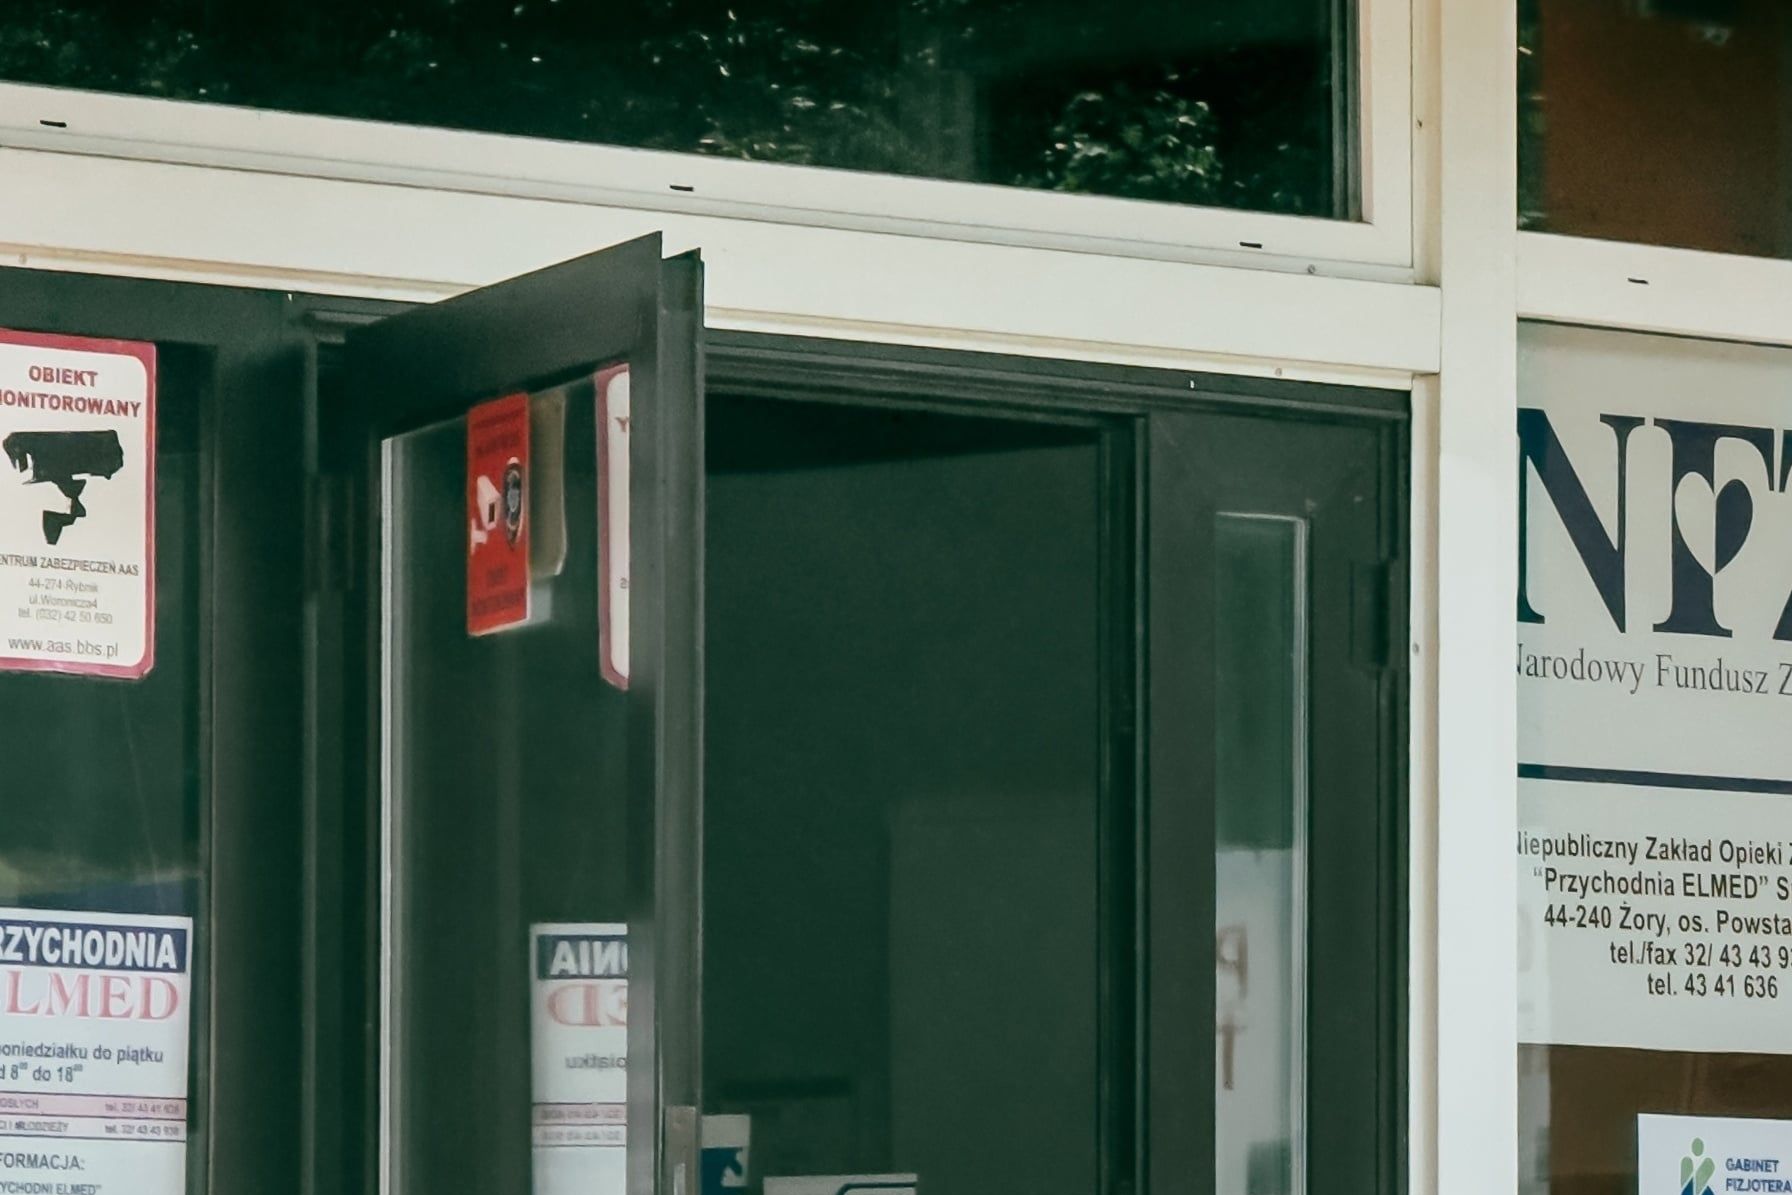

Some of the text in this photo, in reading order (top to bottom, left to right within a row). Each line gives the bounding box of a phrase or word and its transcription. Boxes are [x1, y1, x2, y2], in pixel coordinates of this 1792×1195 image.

[29, 365, 98, 387] OBIEKT
[116, 562, 139, 577] AAS
[1655, 654, 1769, 695] Fundusz
[1645, 836, 1712, 862] Zakład
[1718, 839, 1782, 868] Opieki
[1544, 903, 1612, 929] 44-240
[1618, 900, 1672, 938] Żory,
[1678, 911, 1710, 933] os.
[0, 925, 178, 970] ZYCHODNIA
[1609, 941, 1678, 966] tel./fax
[1684, 942, 1713, 967] 32/
[1719, 944, 1741, 967] 43
[1748, 945, 1772, 969] 43
[1647, 972, 1779, 999] tel. 43 41 636
[93, 1043, 112, 1060] do
[117, 1045, 163, 1066] piątku
[32, 1067, 51, 1082] do
[1725, 1158, 1780, 1173] GABINET
